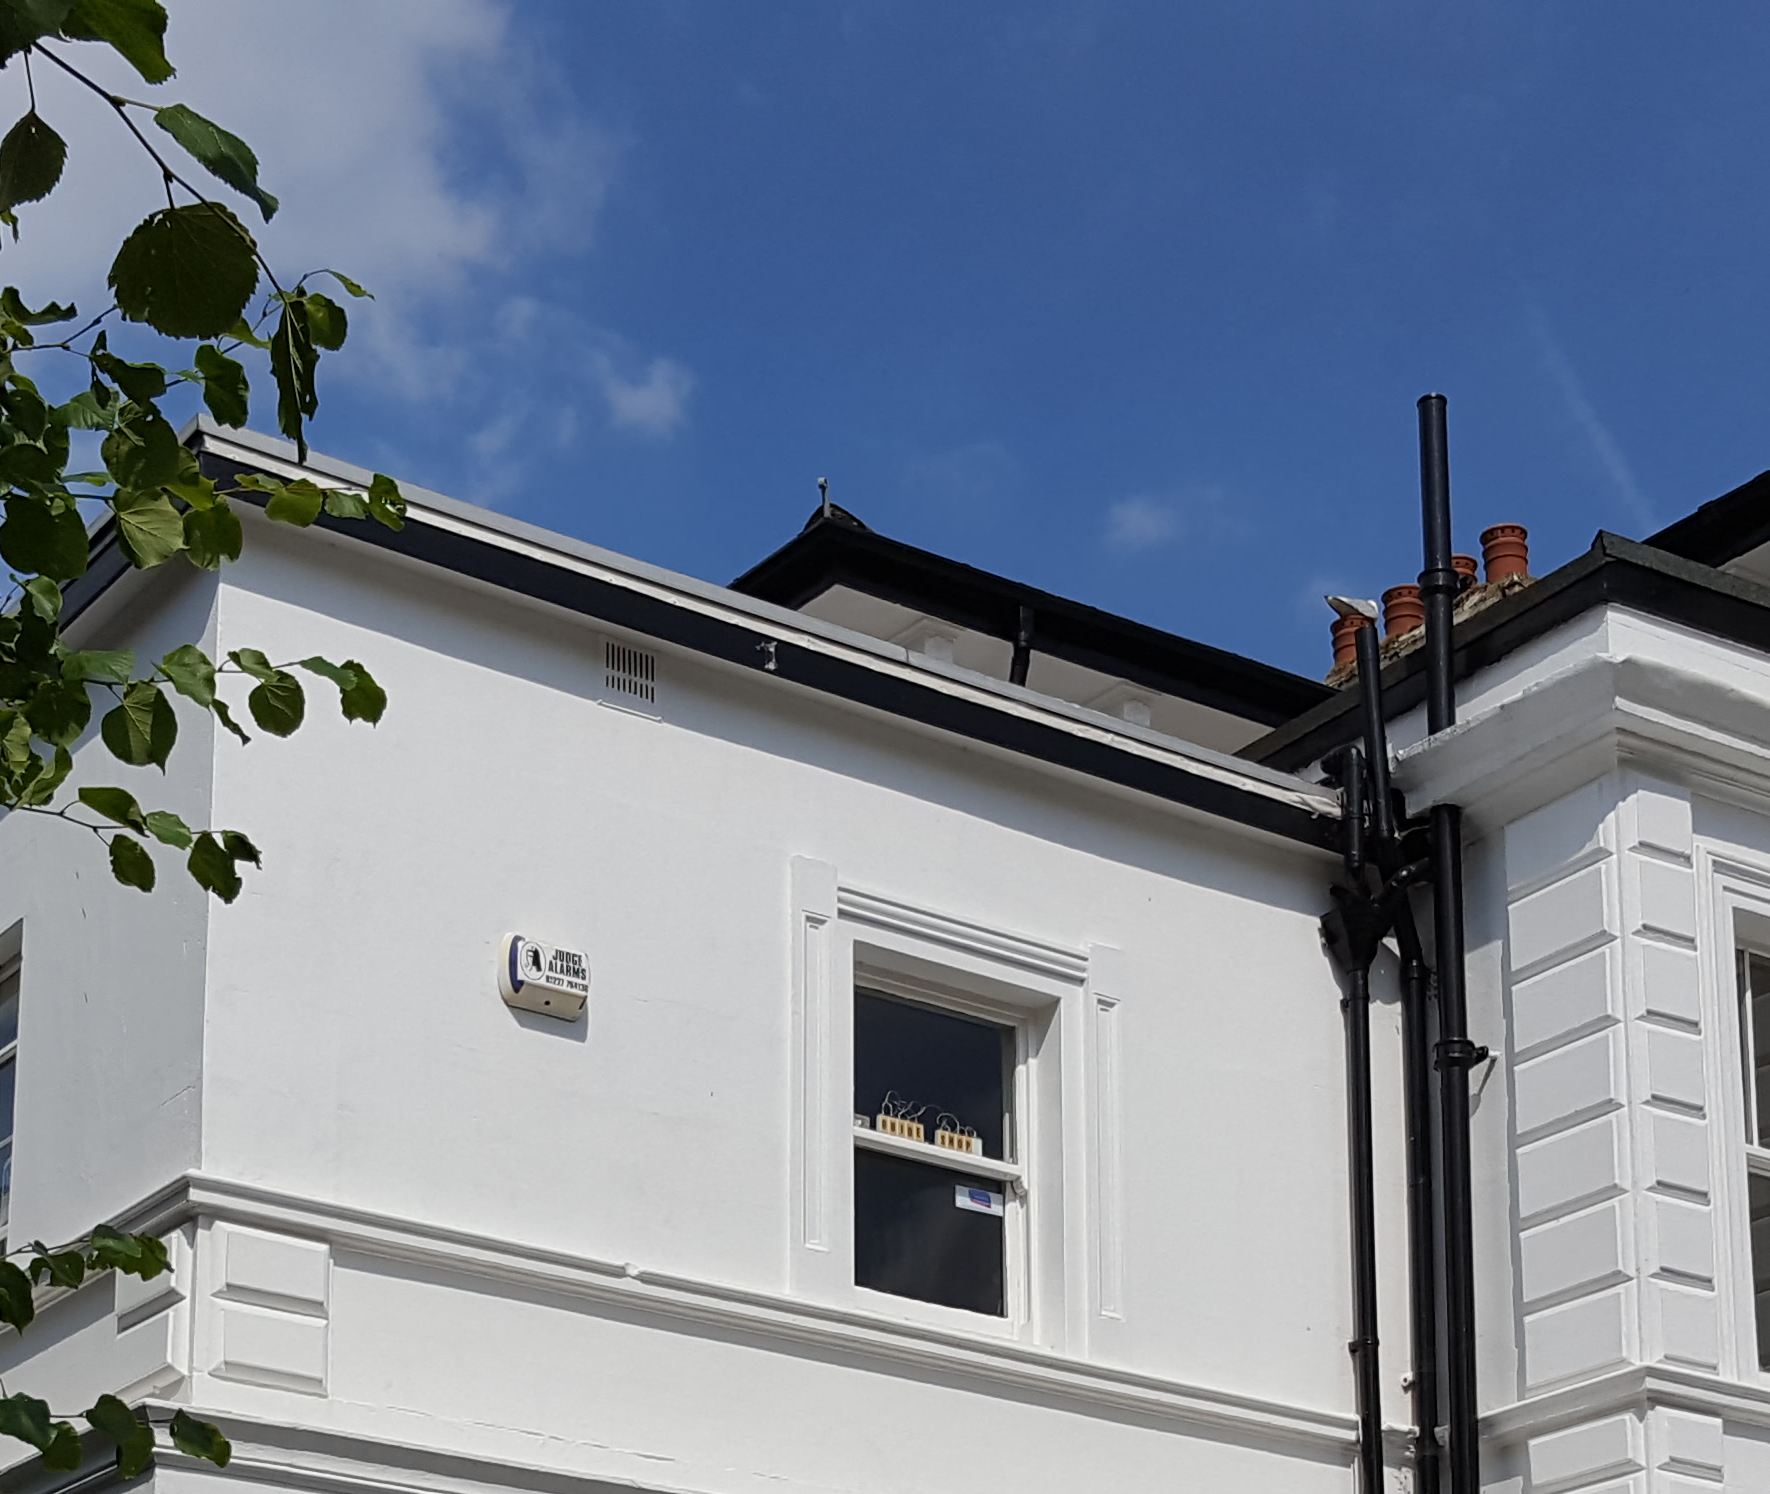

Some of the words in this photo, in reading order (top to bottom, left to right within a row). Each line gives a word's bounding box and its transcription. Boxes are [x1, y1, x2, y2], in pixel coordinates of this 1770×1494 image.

[552, 949, 583, 968] JUDGE
[548, 960, 587, 981] ALARMS
[940, 1134, 972, 1152] SHOP
